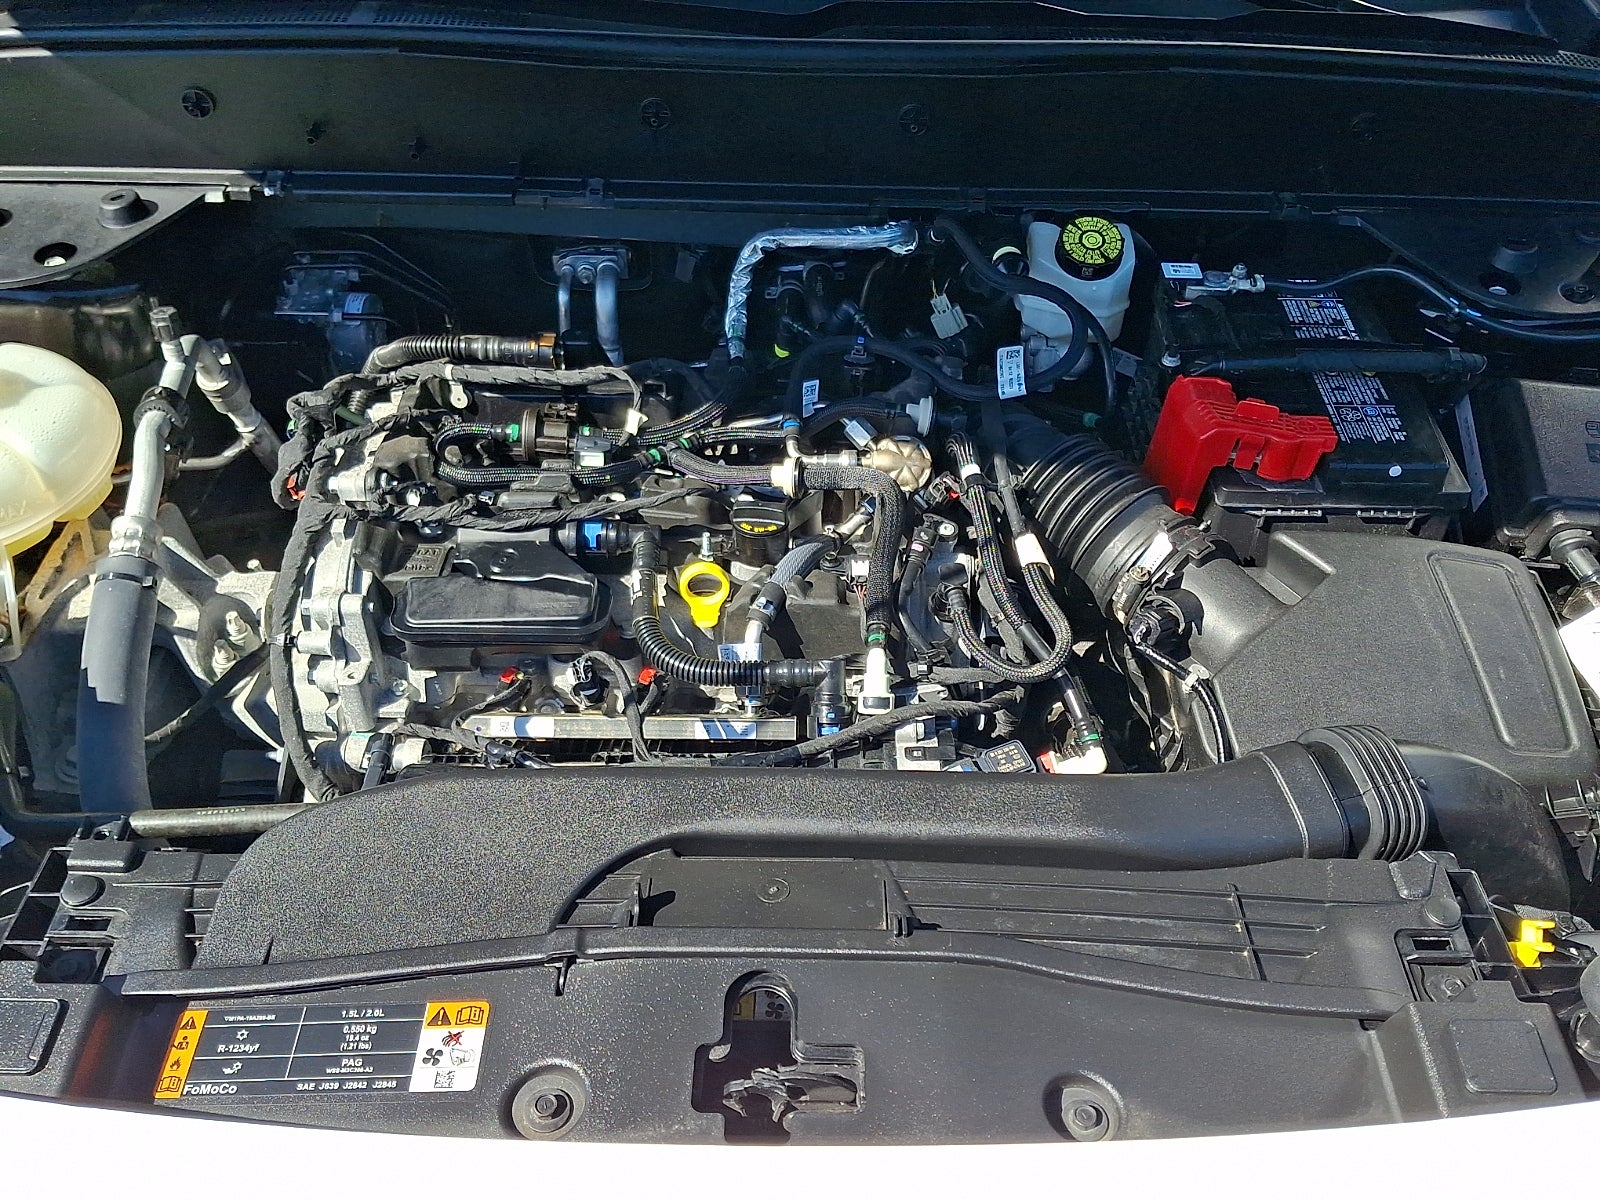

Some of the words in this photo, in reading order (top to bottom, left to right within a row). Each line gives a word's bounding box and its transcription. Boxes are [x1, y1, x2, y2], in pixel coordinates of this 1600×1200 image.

[341, 1010, 359, 1018] 1.5L
[365, 1008, 385, 1018] 2.0L
[343, 1025, 365, 1034] 0.550
[366, 1024, 378, 1035] kg
[217, 1043, 260, 1054] R-1234yf
[341, 1058, 363, 1068] PAG
[183, 1083, 238, 1096] FoMoCo
[296, 1083, 316, 1091] SAE
